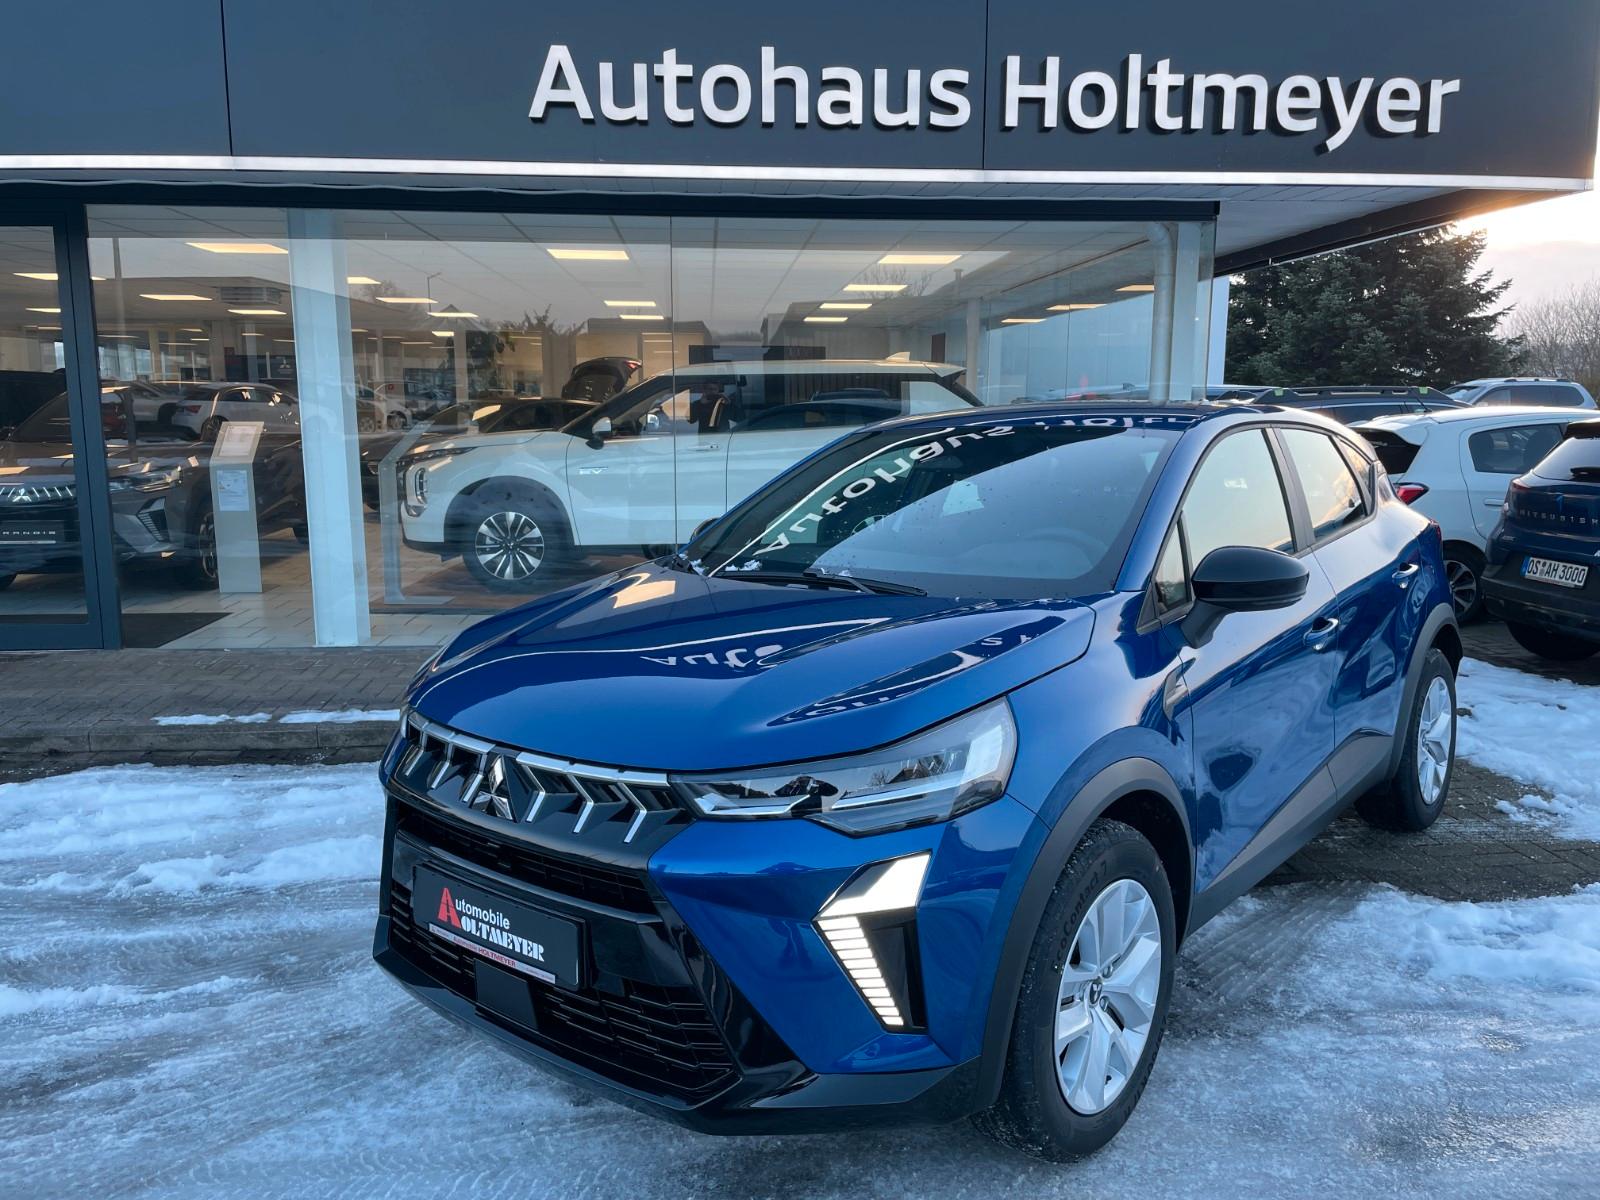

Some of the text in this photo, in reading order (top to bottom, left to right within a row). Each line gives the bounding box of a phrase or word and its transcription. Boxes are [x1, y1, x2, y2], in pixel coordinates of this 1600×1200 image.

[528, 45, 1461, 153] Autohaus Holtmeyer
[1520, 508, 1599, 524] MITSUBISH
[1527, 559, 1541, 576] OS
[1545, 562, 1560, 578] AH
[1559, 565, 1586, 584] 3000
